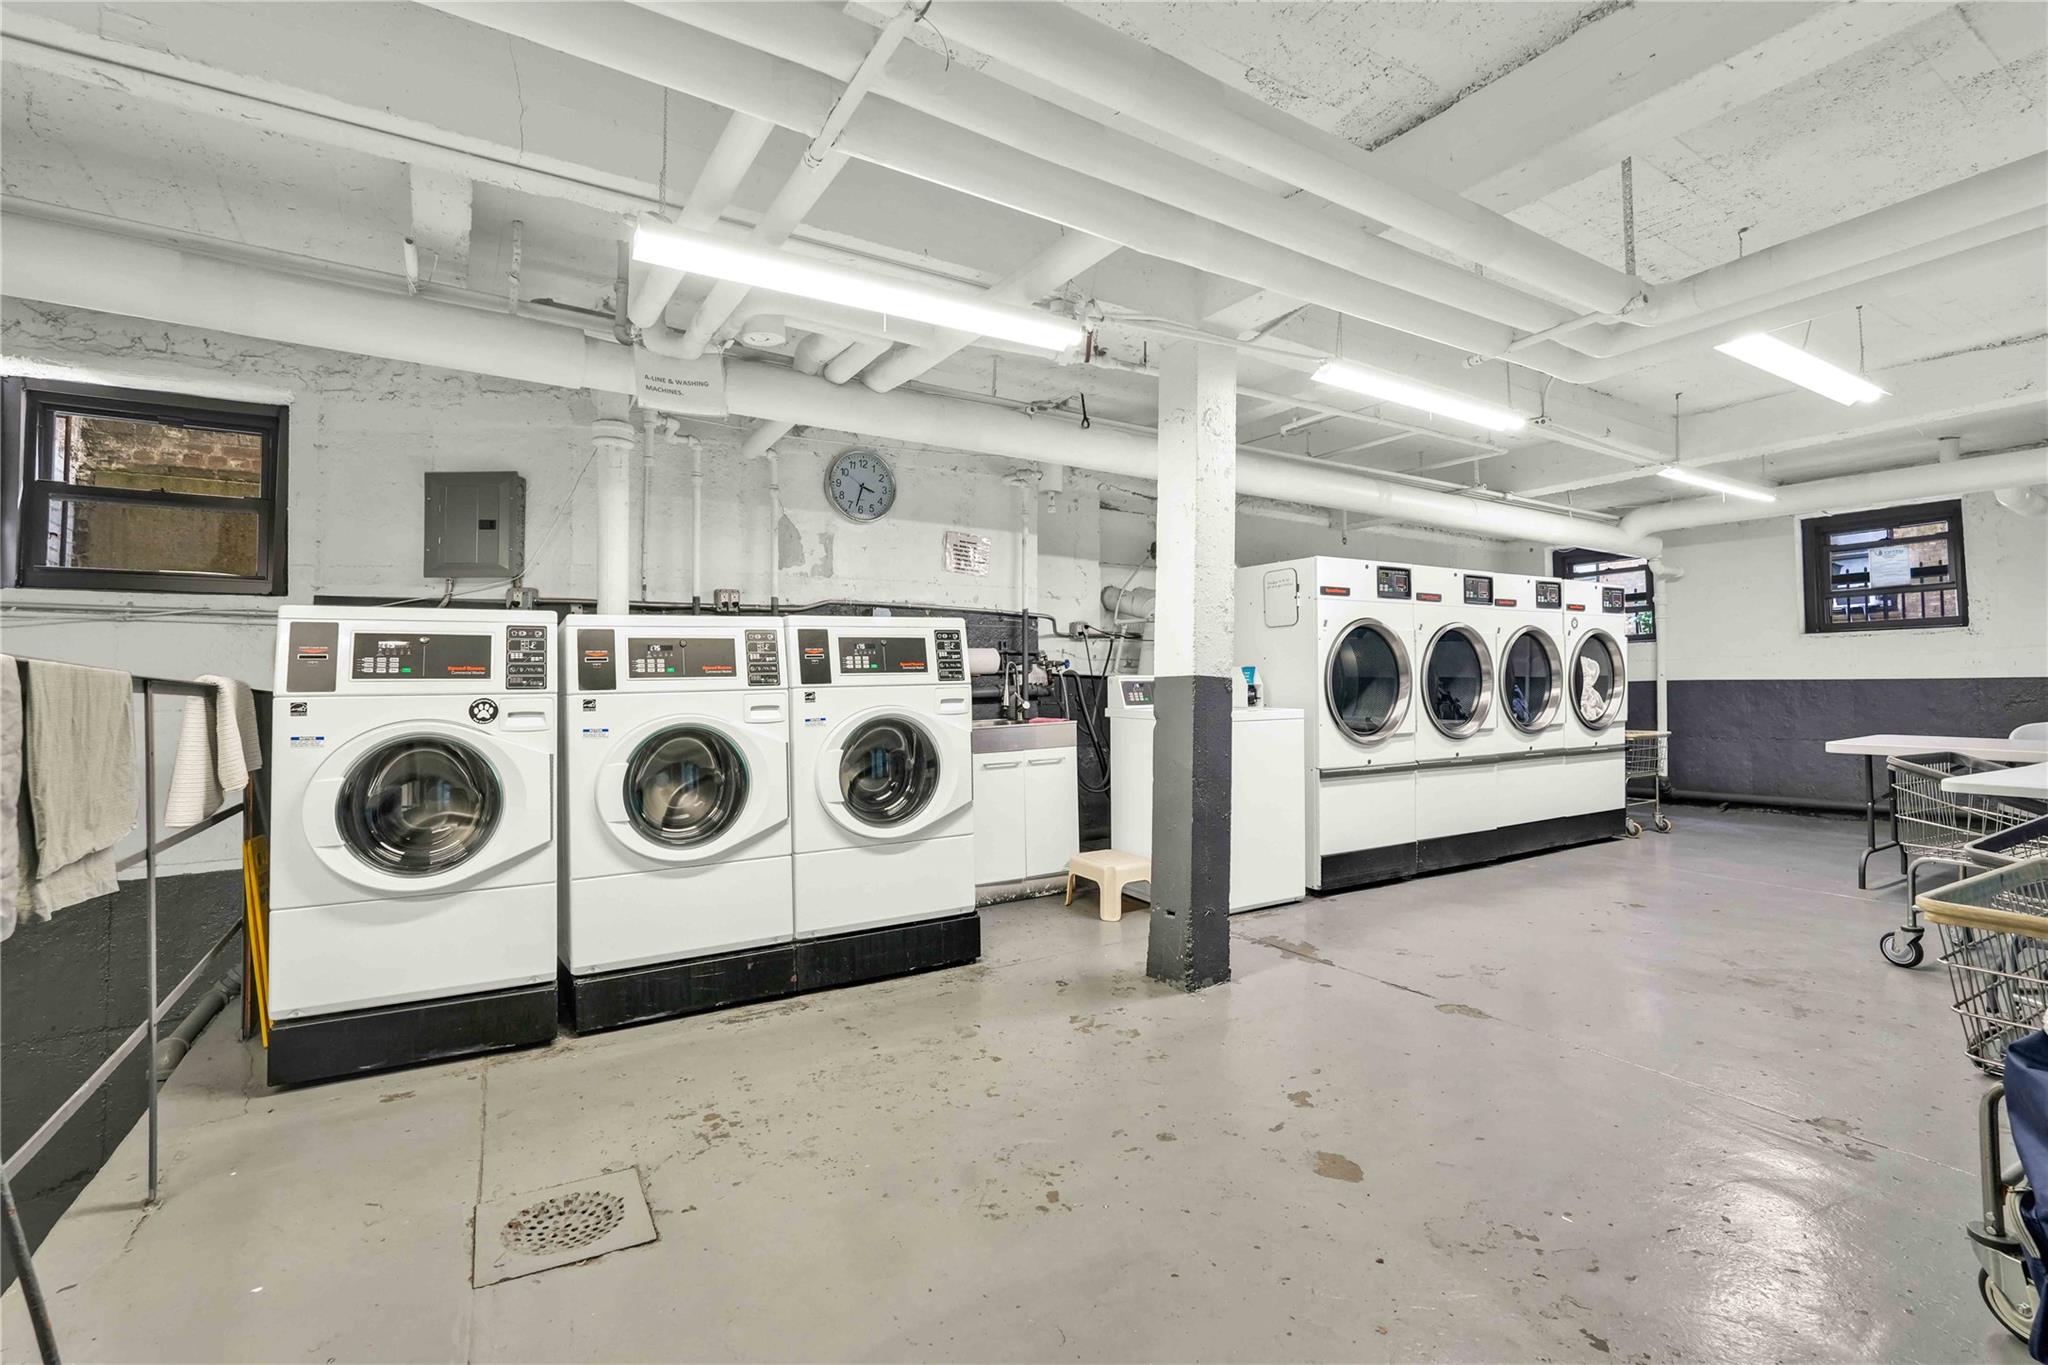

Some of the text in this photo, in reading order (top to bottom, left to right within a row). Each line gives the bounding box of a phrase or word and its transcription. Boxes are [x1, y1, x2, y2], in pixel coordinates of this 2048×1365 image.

[849, 461, 855, 469] 11
[860, 460, 868, 469] 12
[841, 468, 849, 476] 10
[872, 465, 876, 473] 1
[879, 474, 884, 482] 2
[836, 479, 841, 487] 9
[882, 486, 887, 494] 3
[839, 491, 844, 499] 8
[848, 500, 853, 509] 7
[877, 498, 883, 506] 4
[858, 505, 863, 514] 6
[869, 504, 874, 512] 5
